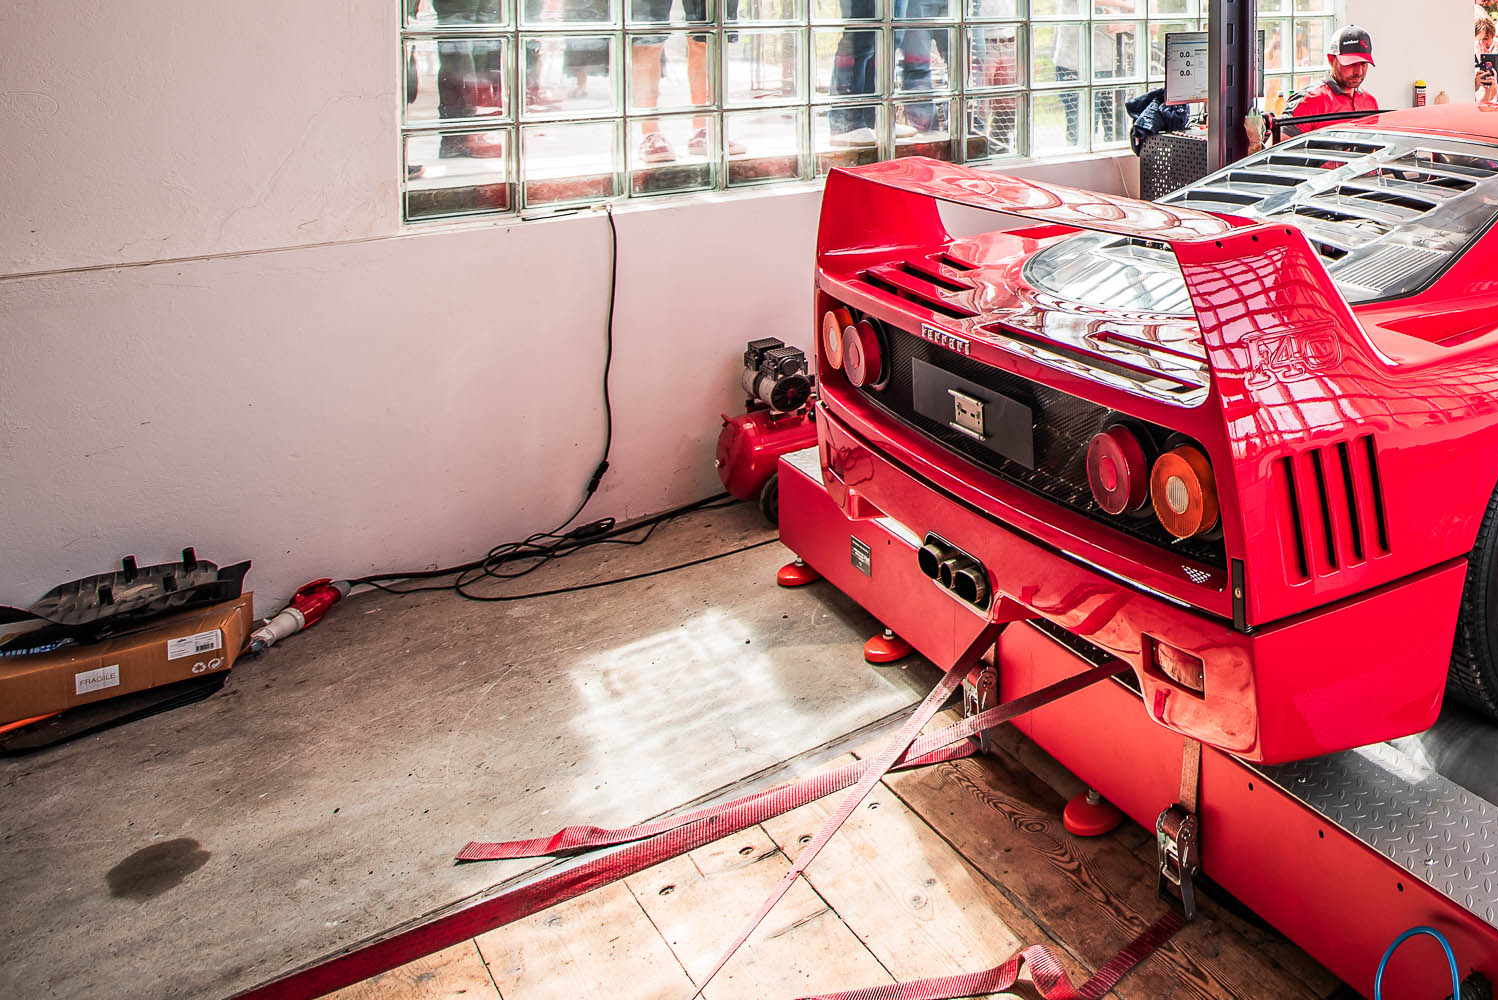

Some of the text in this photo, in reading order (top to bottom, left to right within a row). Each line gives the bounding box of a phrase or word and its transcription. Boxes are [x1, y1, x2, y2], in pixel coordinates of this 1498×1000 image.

[921, 323, 970, 355] Ferrari
[1241, 321, 1341, 391] F40
[80, 672, 116, 686] FRAGILE
